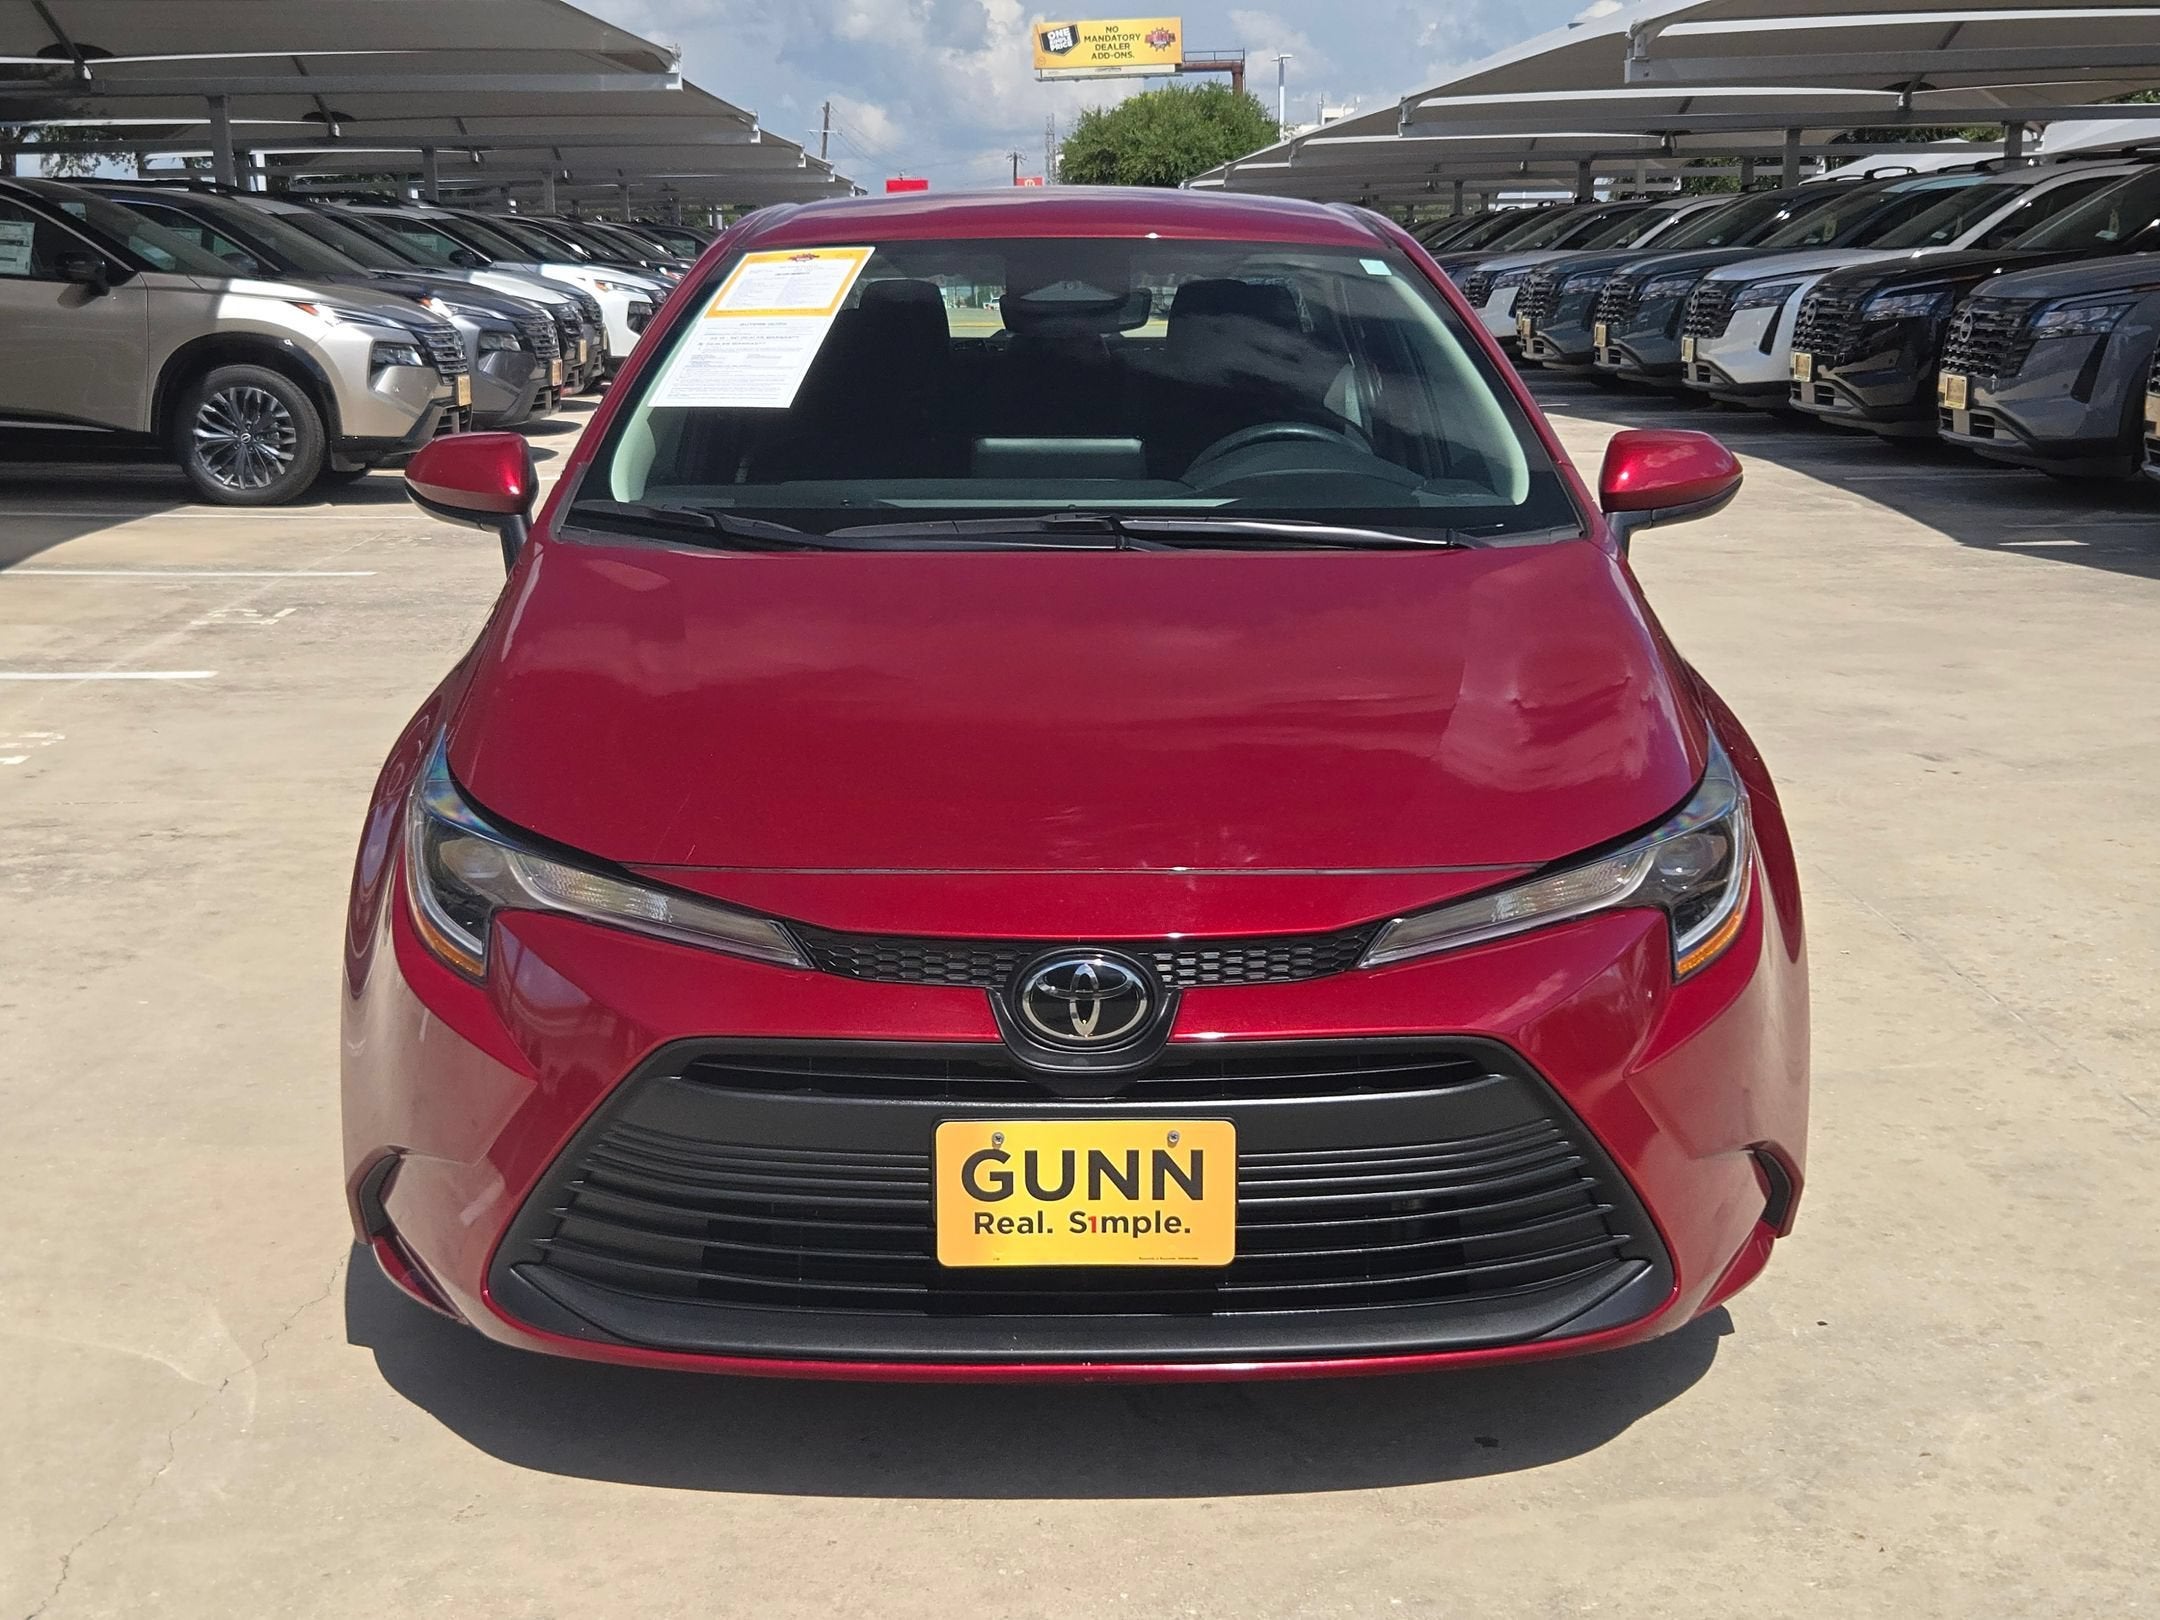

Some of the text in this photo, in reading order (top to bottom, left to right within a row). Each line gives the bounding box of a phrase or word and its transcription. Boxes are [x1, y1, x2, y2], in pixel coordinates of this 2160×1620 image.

[1047, 27, 1070, 39] ONE
[1084, 33, 1141, 42] MANDATORY
[1095, 43, 1131, 51] DEALER
[1091, 51, 1135, 60] ADD-ONS.
[961, 1148, 1204, 1203] GUNN
[974, 1211, 1054, 1235] Real.
